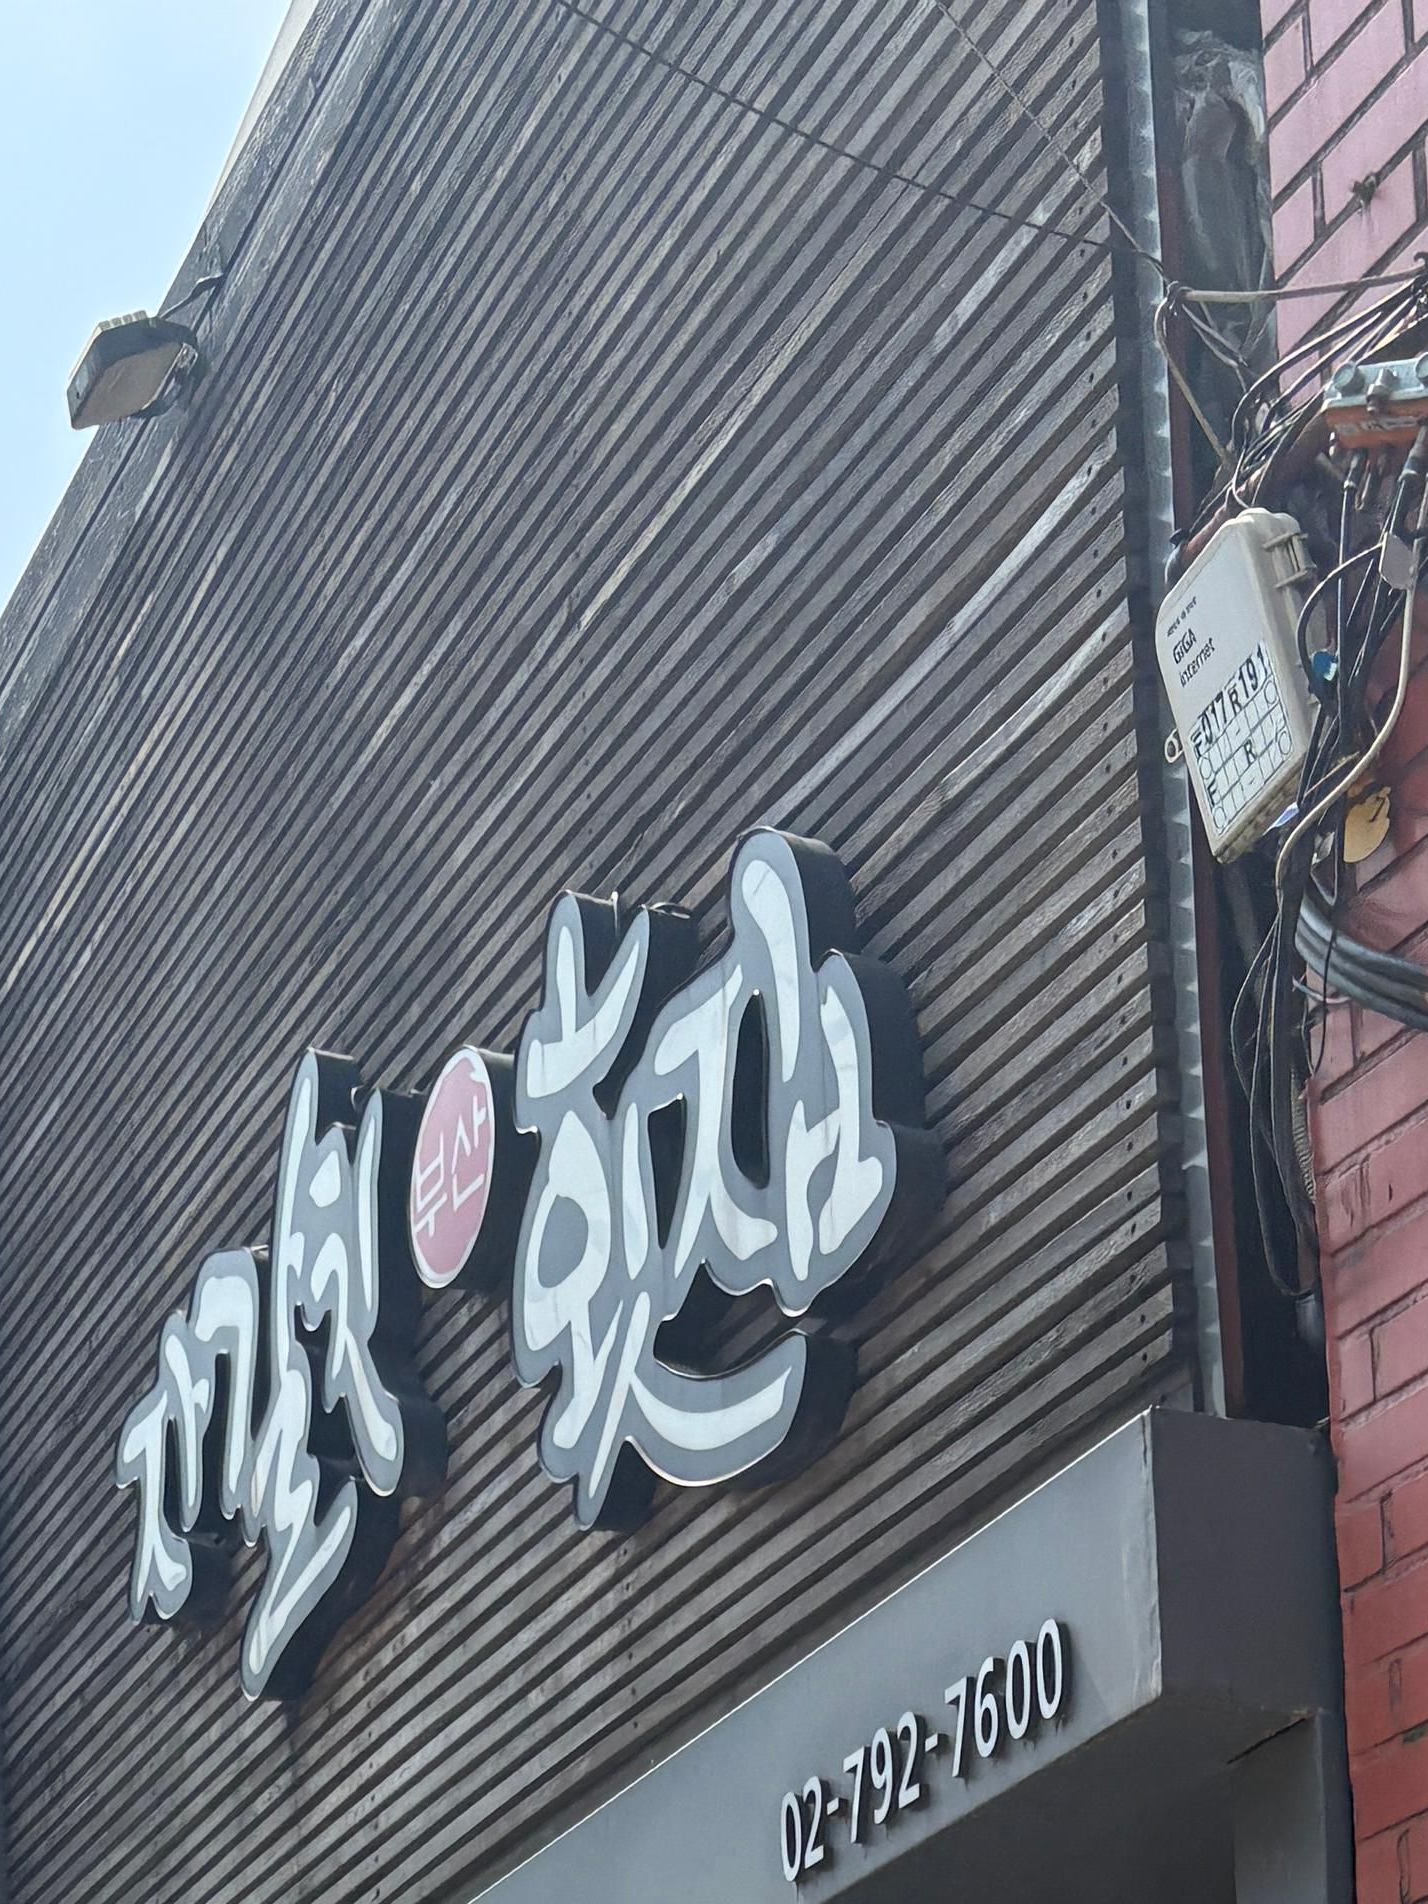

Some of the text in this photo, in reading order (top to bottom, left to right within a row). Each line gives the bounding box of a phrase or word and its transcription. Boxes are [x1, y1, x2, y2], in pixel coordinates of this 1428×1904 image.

[119, 1060, 402, 1690] 자갈치
[520, 840, 892, 1518] 횟집
[780, 1618, 1062, 1882] 02-792-7600
